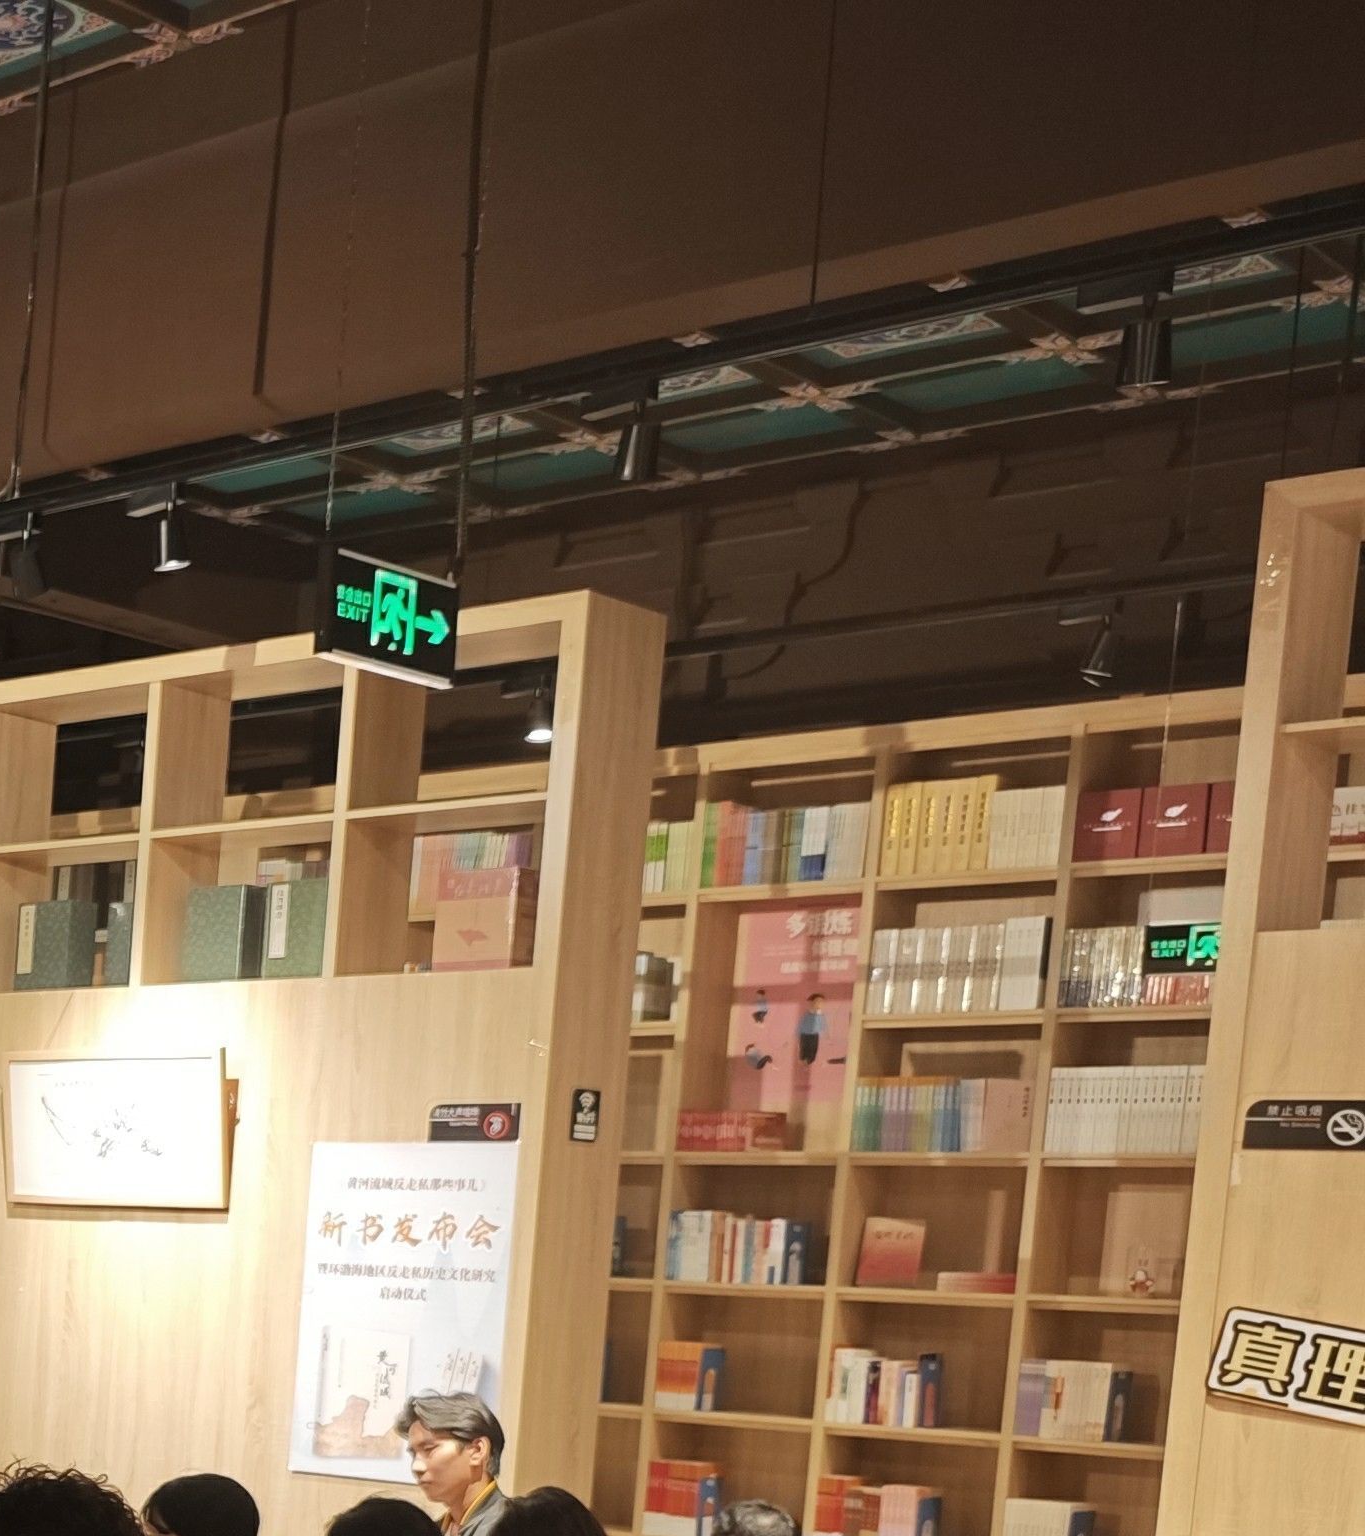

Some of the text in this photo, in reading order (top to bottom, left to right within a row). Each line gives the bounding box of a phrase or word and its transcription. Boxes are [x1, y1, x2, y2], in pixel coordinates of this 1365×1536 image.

[337, 602, 370, 622] EXIT
[1266, 1105, 1323, 1117] 禁止吸烟
[317, 1210, 501, 1250] 新书发布会
[379, 1287, 428, 1302] 启动仪式
